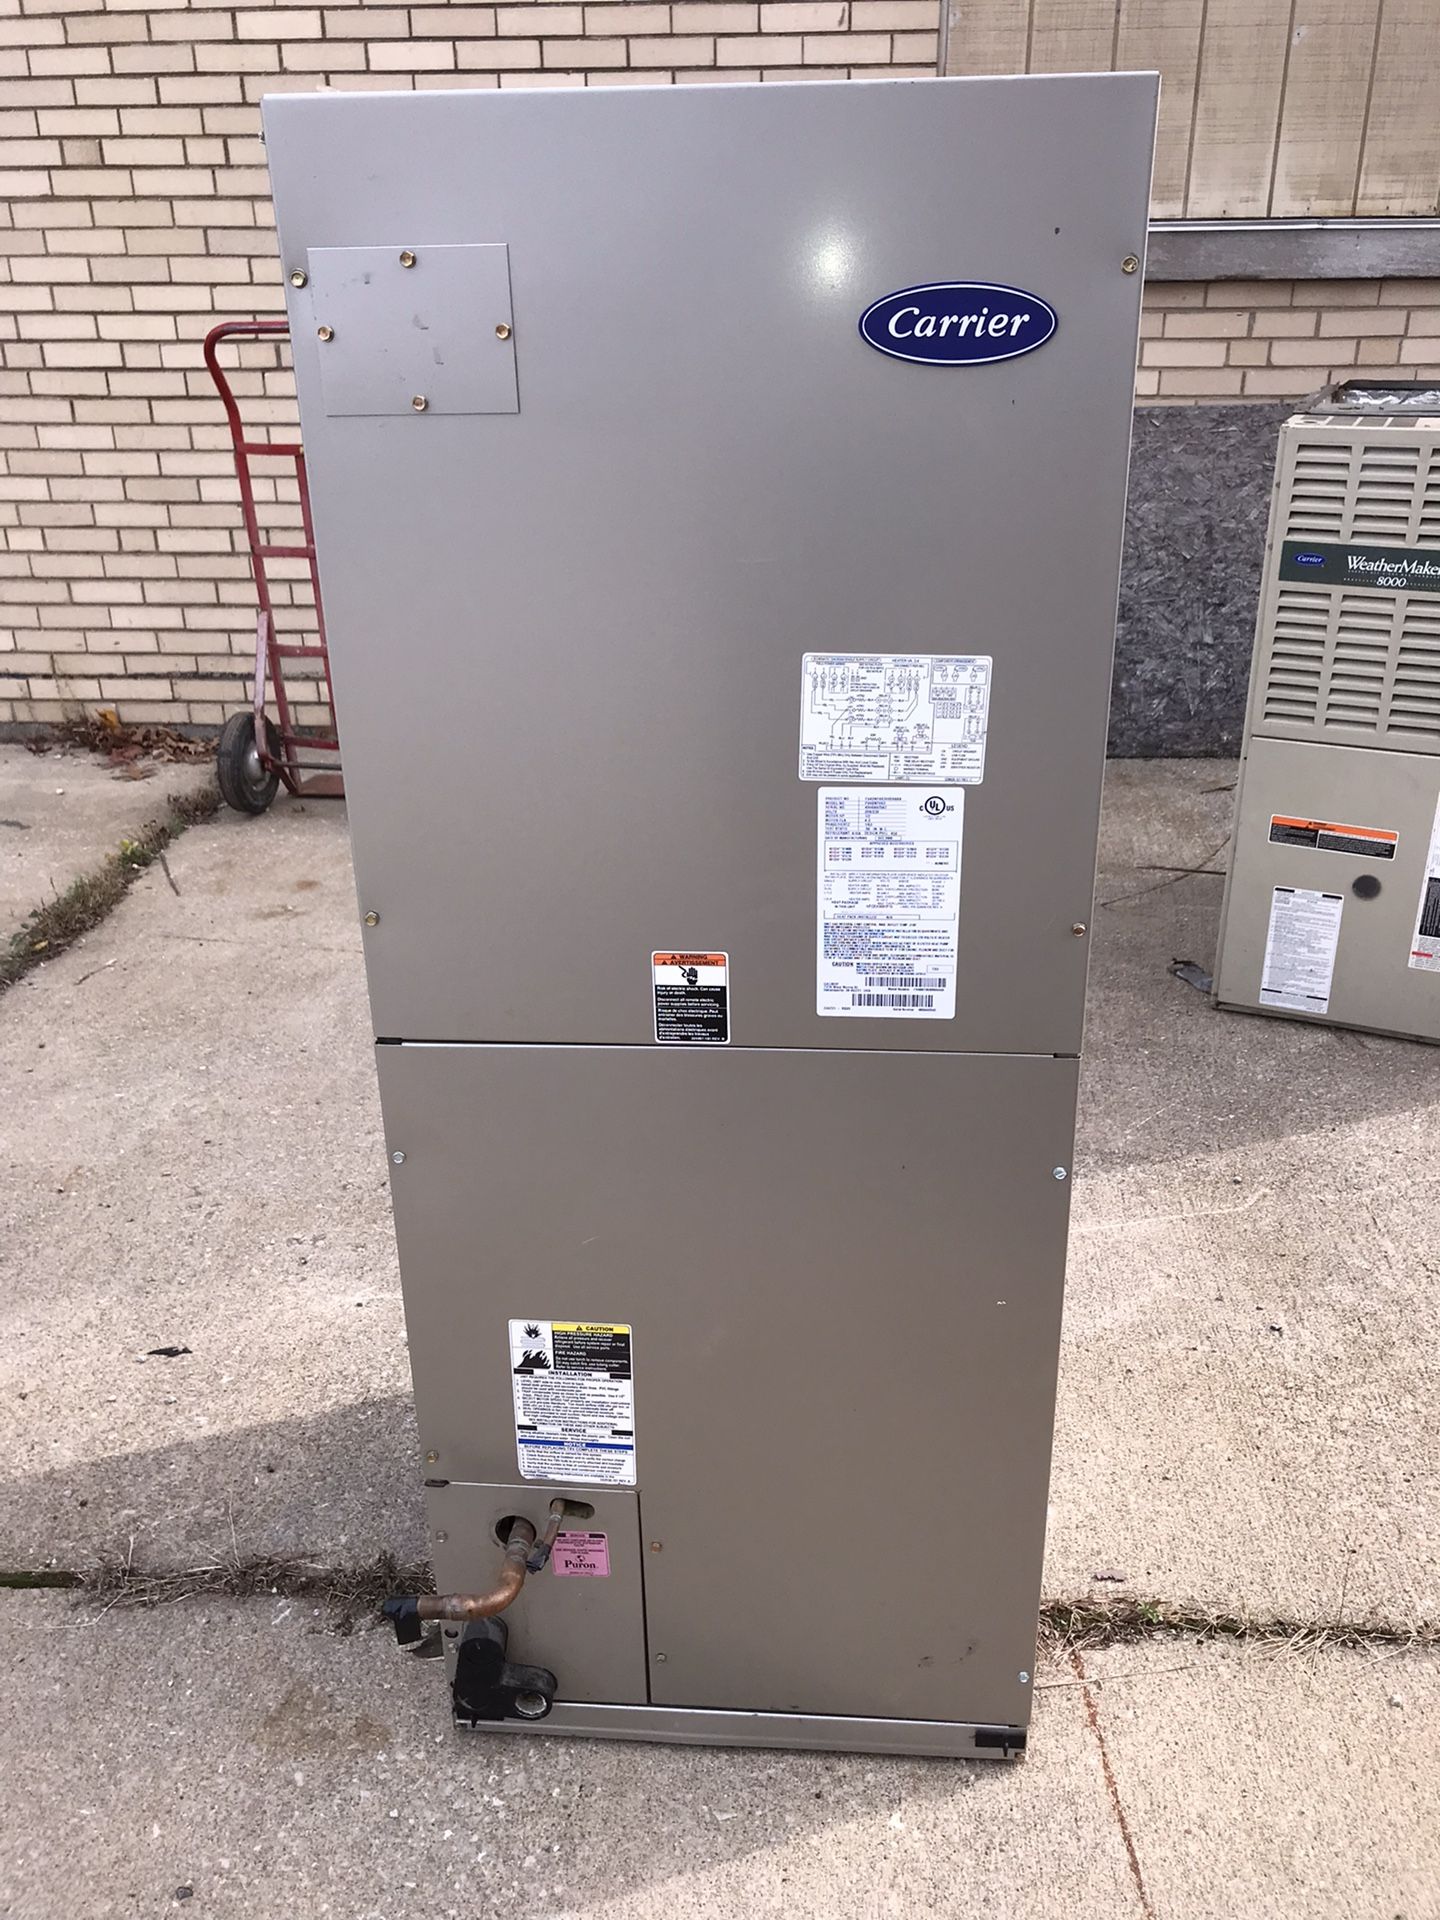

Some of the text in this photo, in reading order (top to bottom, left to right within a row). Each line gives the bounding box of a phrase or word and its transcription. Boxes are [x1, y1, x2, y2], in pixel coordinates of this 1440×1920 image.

[888, 307, 1030, 338] Carrier
[1297, 555, 1322, 563] Carrier
[1376, 576, 1407, 588] 8000
[565, 1560, 596, 1568] Puron
